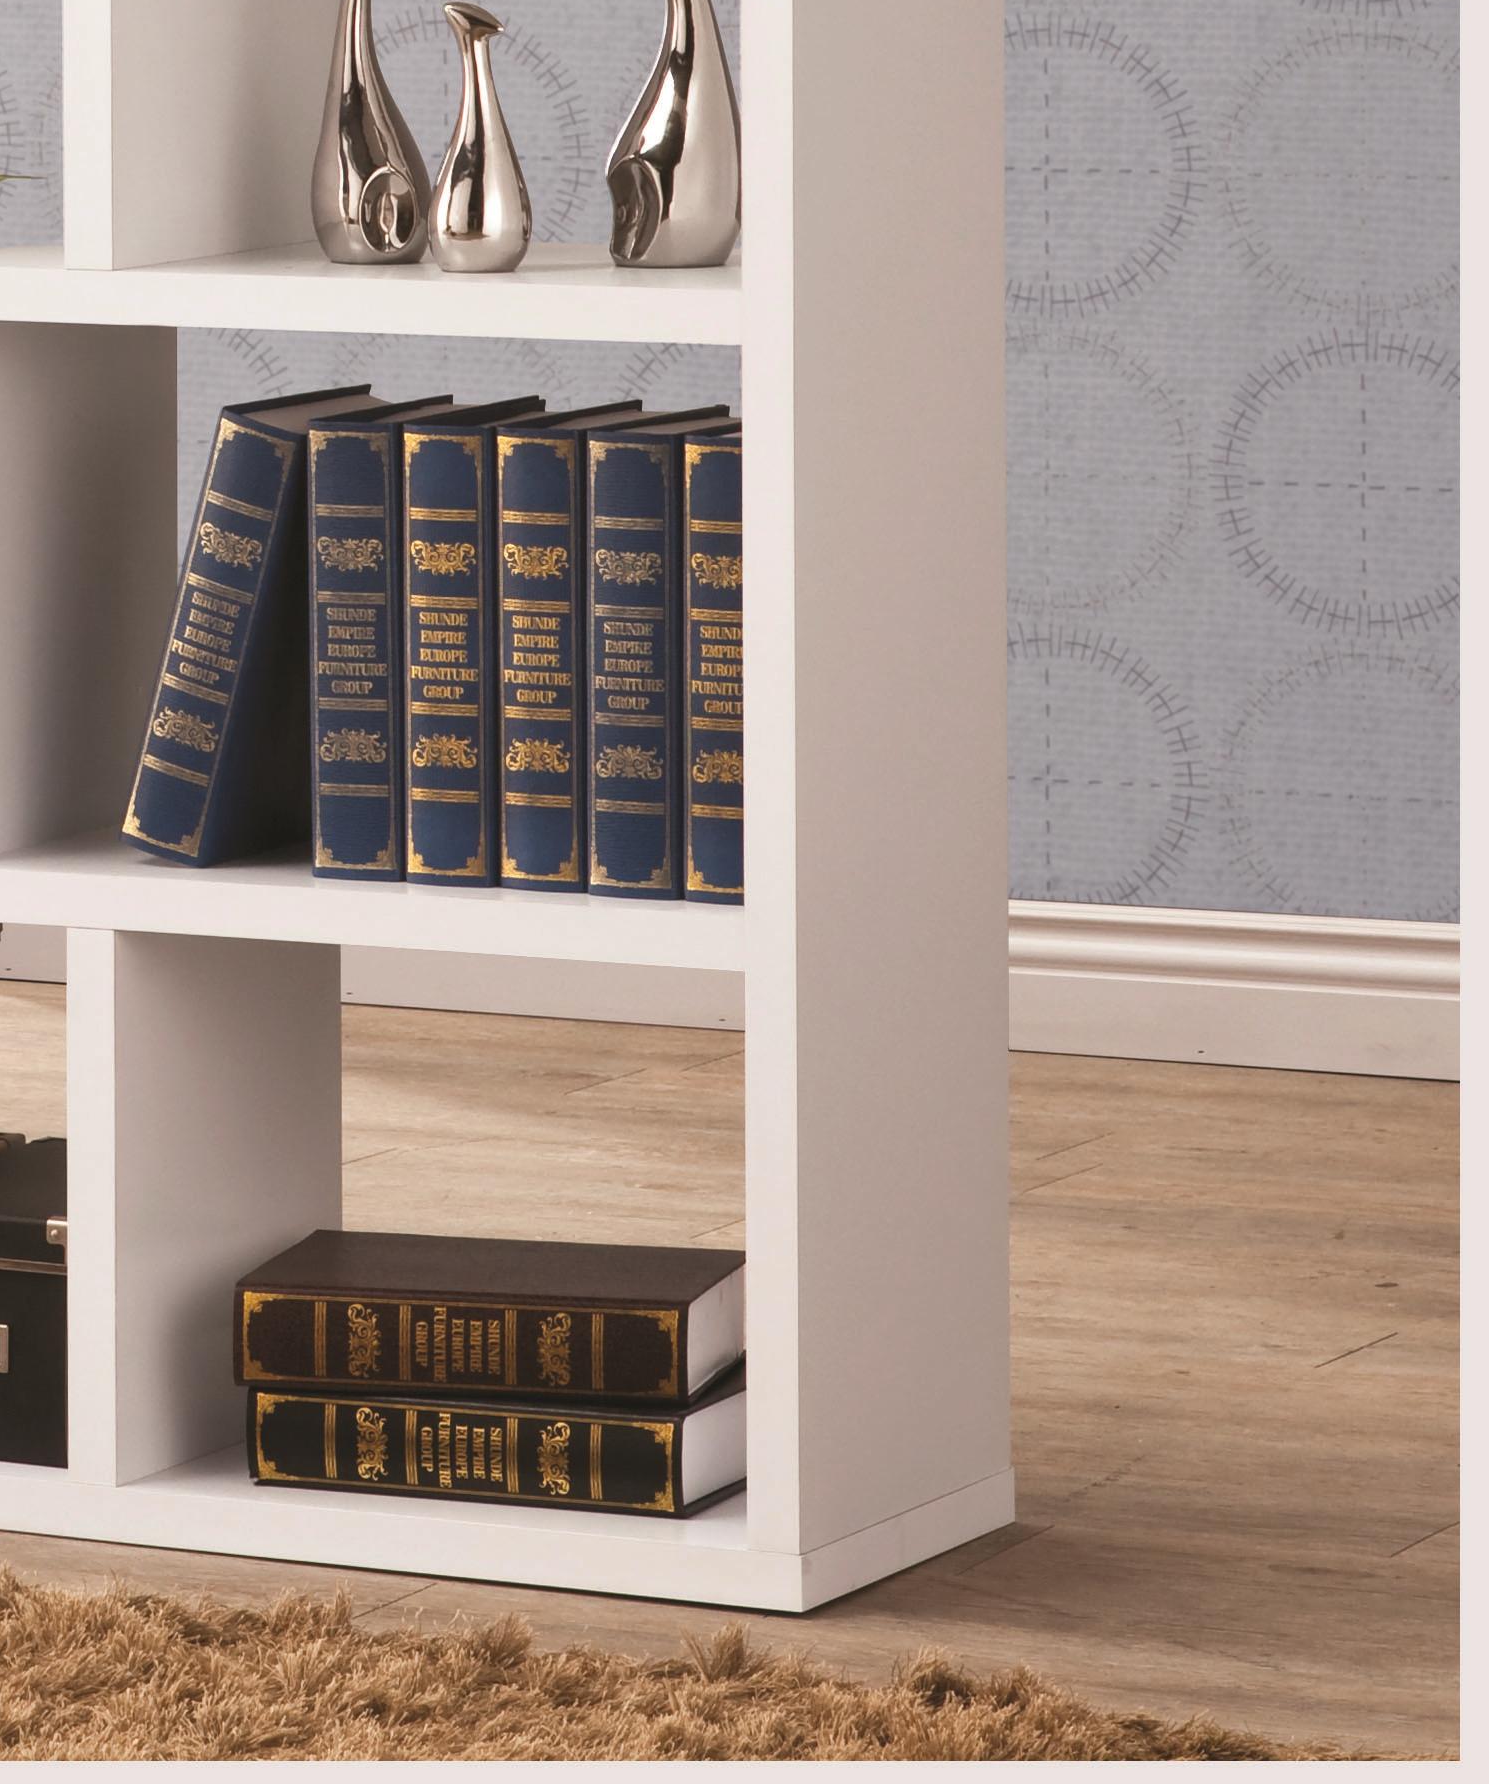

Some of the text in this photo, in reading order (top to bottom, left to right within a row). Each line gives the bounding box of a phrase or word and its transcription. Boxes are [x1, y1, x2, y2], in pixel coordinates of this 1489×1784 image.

[191, 591, 240, 618] SHUNDE
[189, 608, 235, 635] EMPIRE
[326, 607, 377, 622] SHUNDE
[419, 611, 469, 626] SHUNDE
[512, 615, 561, 630] SHUNDE
[328, 625, 375, 640] EMPIRE
[420, 629, 467, 645] EMPIRE
[603, 621, 654, 637] SHUNDE
[700, 625, 743, 640] SHUND
[184, 625, 232, 653] EUROPE
[513, 633, 560, 649] EMPIRE
[605, 639, 653, 655] EMPIRE
[172, 639, 238, 673] FURNITURE
[327, 643, 376, 658] EUROPE
[419, 648, 468, 663] EUROPE
[701, 644, 743, 659] EMPIR
[512, 652, 561, 667] EUROPE
[604, 658, 654, 674] EUROPE
[179, 661, 219, 685] GROUP
[318, 661, 387, 676] FURNITURE
[411, 665, 478, 681] FURNITURE
[700, 662, 743, 677] EUROP
[504, 669, 572, 686] FURNITURE
[595, 675, 665, 692] FURNITURE
[331, 680, 373, 695] GROUP
[423, 685, 464, 700] GROUP
[691, 680, 743, 696] FURNITU
[516, 689, 557, 704] GROUP
[608, 695, 650, 710] GROUP
[415, 1320, 429, 1368] GROUP
[433, 1305, 448, 1383] FURNITURE
[452, 1319, 465, 1373] EUROPE
[469, 1320, 483, 1373] EMPIRE
[487, 1319, 501, 1375] SHUNDE
[421, 1425, 434, 1473] GROUP
[438, 1412, 453, 1489] FURNITURE
[455, 1425, 469, 1479] EUROPE
[472, 1427, 486, 1479] EMPIRE
[490, 1427, 503, 1483] SHUNDE
